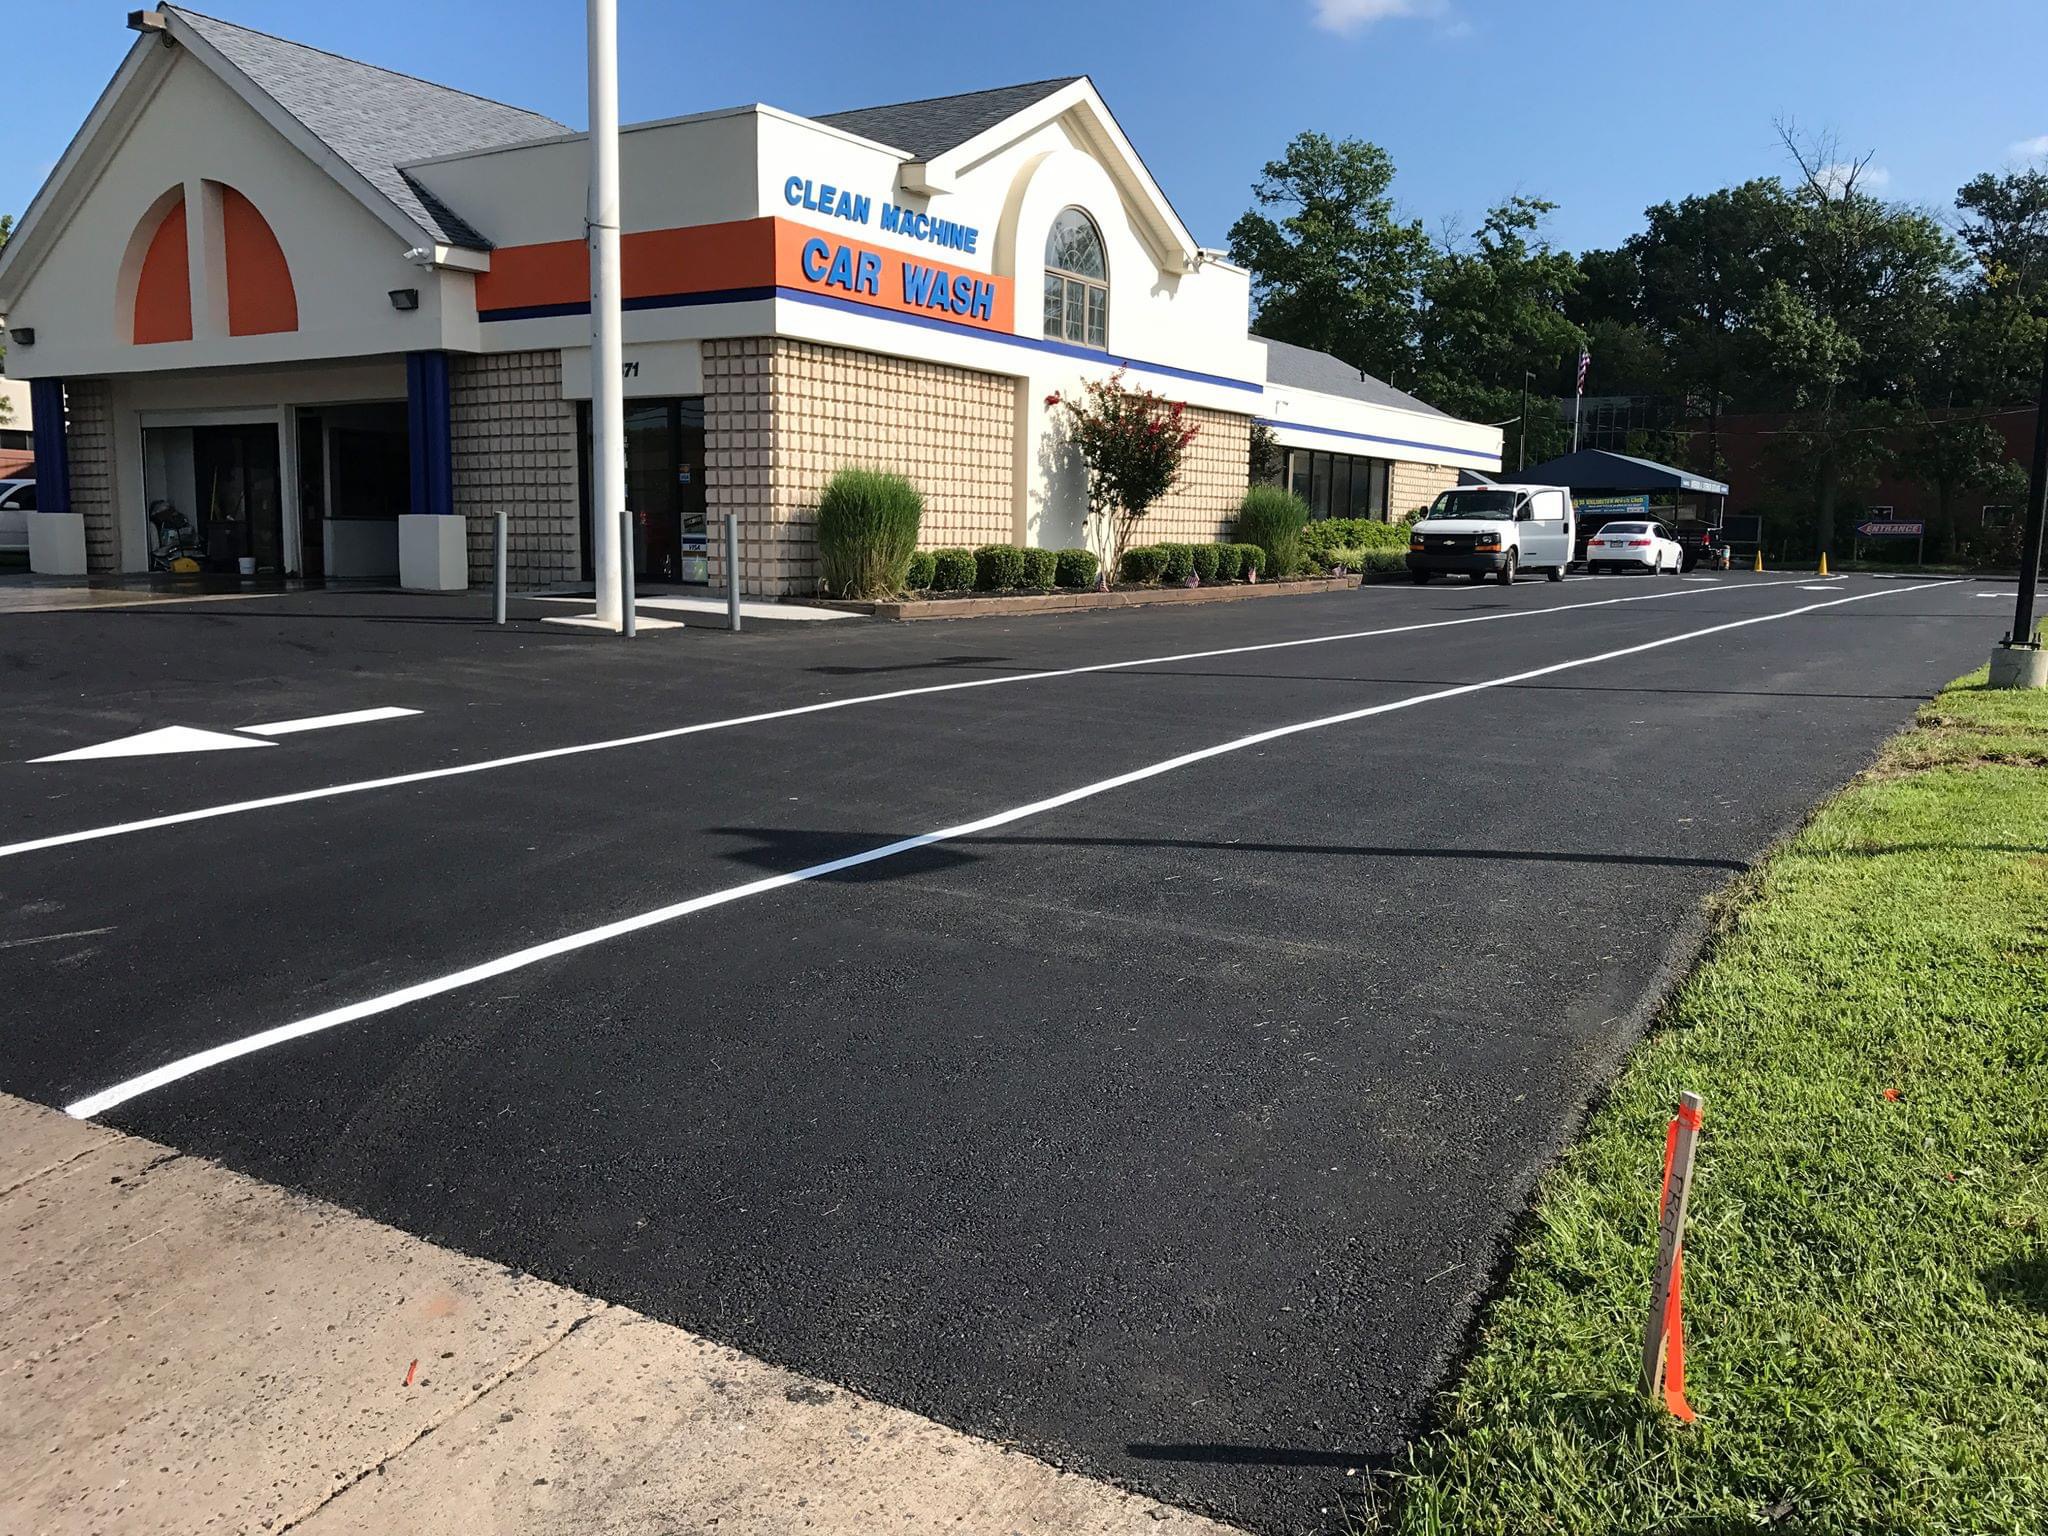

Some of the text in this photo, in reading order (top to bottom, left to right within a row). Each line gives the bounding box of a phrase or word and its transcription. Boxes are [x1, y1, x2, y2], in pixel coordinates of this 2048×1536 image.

[784, 176, 979, 254] CLEAN MACHINE
[802, 237, 996, 321] CAR WASH
[622, 362, 640, 378] 71
[1866, 525, 1919, 533] ENTRANCE
